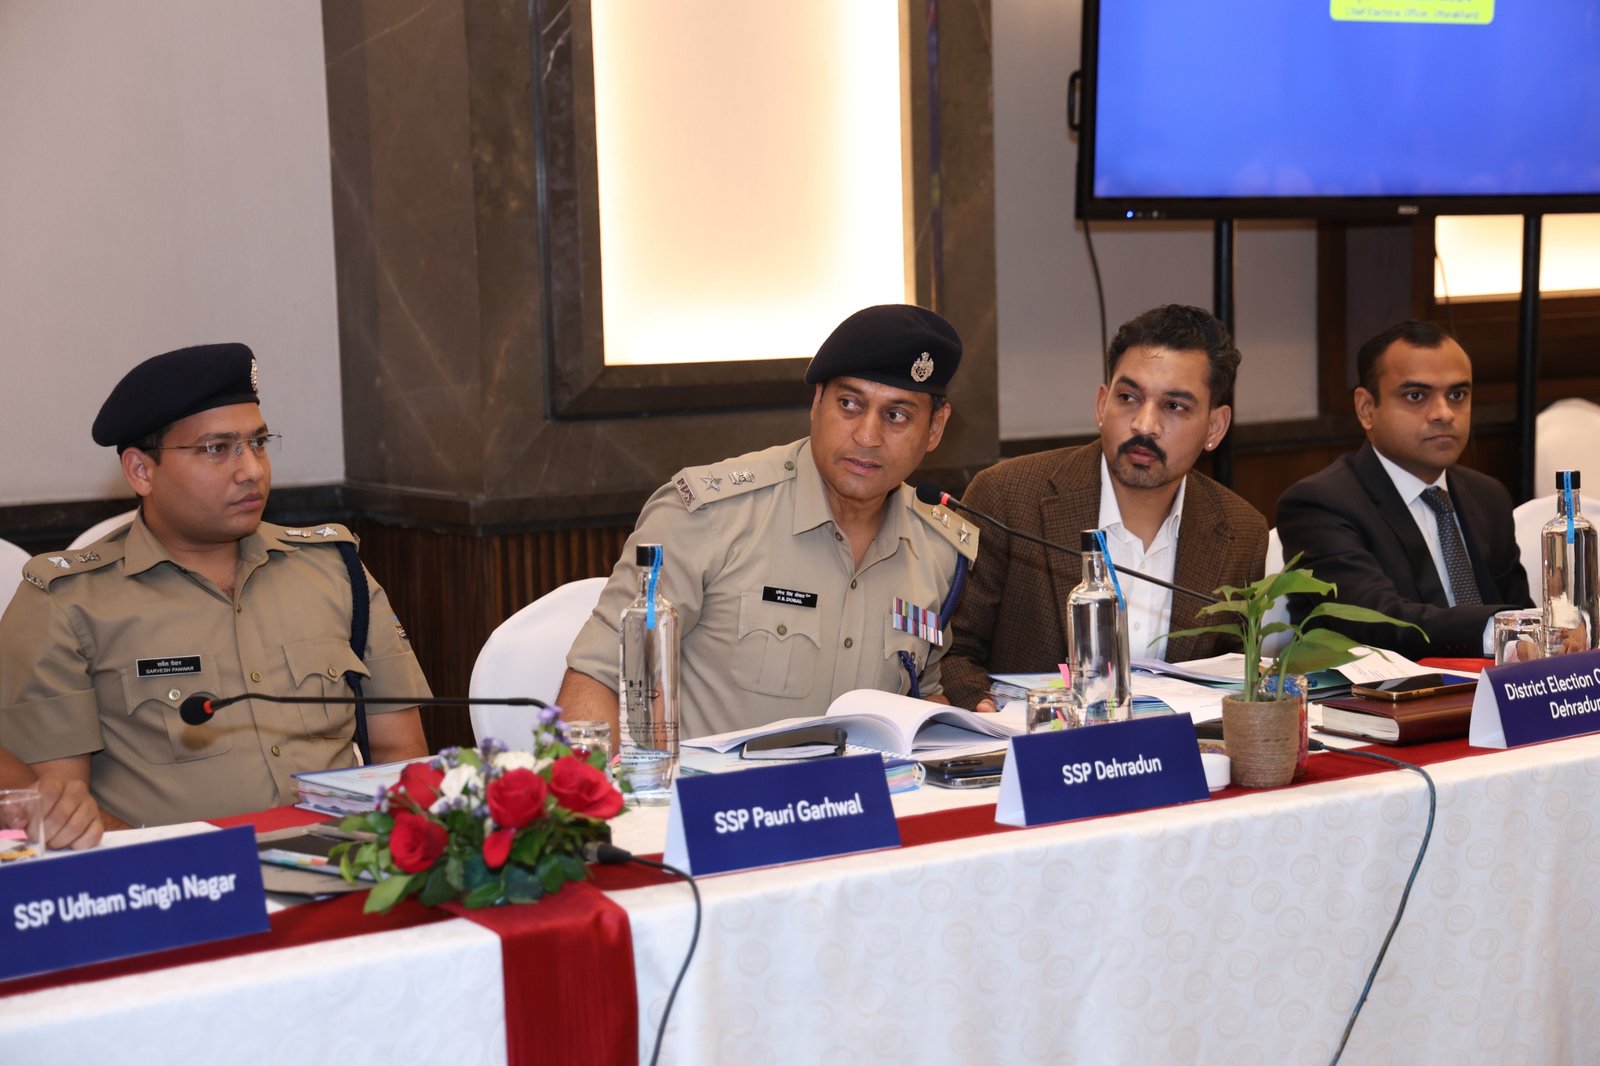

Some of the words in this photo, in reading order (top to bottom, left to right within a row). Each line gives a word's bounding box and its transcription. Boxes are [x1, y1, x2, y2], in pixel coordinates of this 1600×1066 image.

[171, 665, 194, 673] PANWAR
[1504, 681, 1548, 701] District
[1546, 673, 1594, 693] Election
[1062, 762, 1092, 785] SSP
[1094, 753, 1163, 781] Dehradun
[714, 808, 750, 834] SSP
[752, 803, 795, 828] Pauri
[796, 792, 864, 822] Garhwal
[13, 899, 55, 931] SSP
[57, 890, 127, 922] Udham
[127, 877, 182, 911] Singh
[182, 873, 237, 901] Nagar
